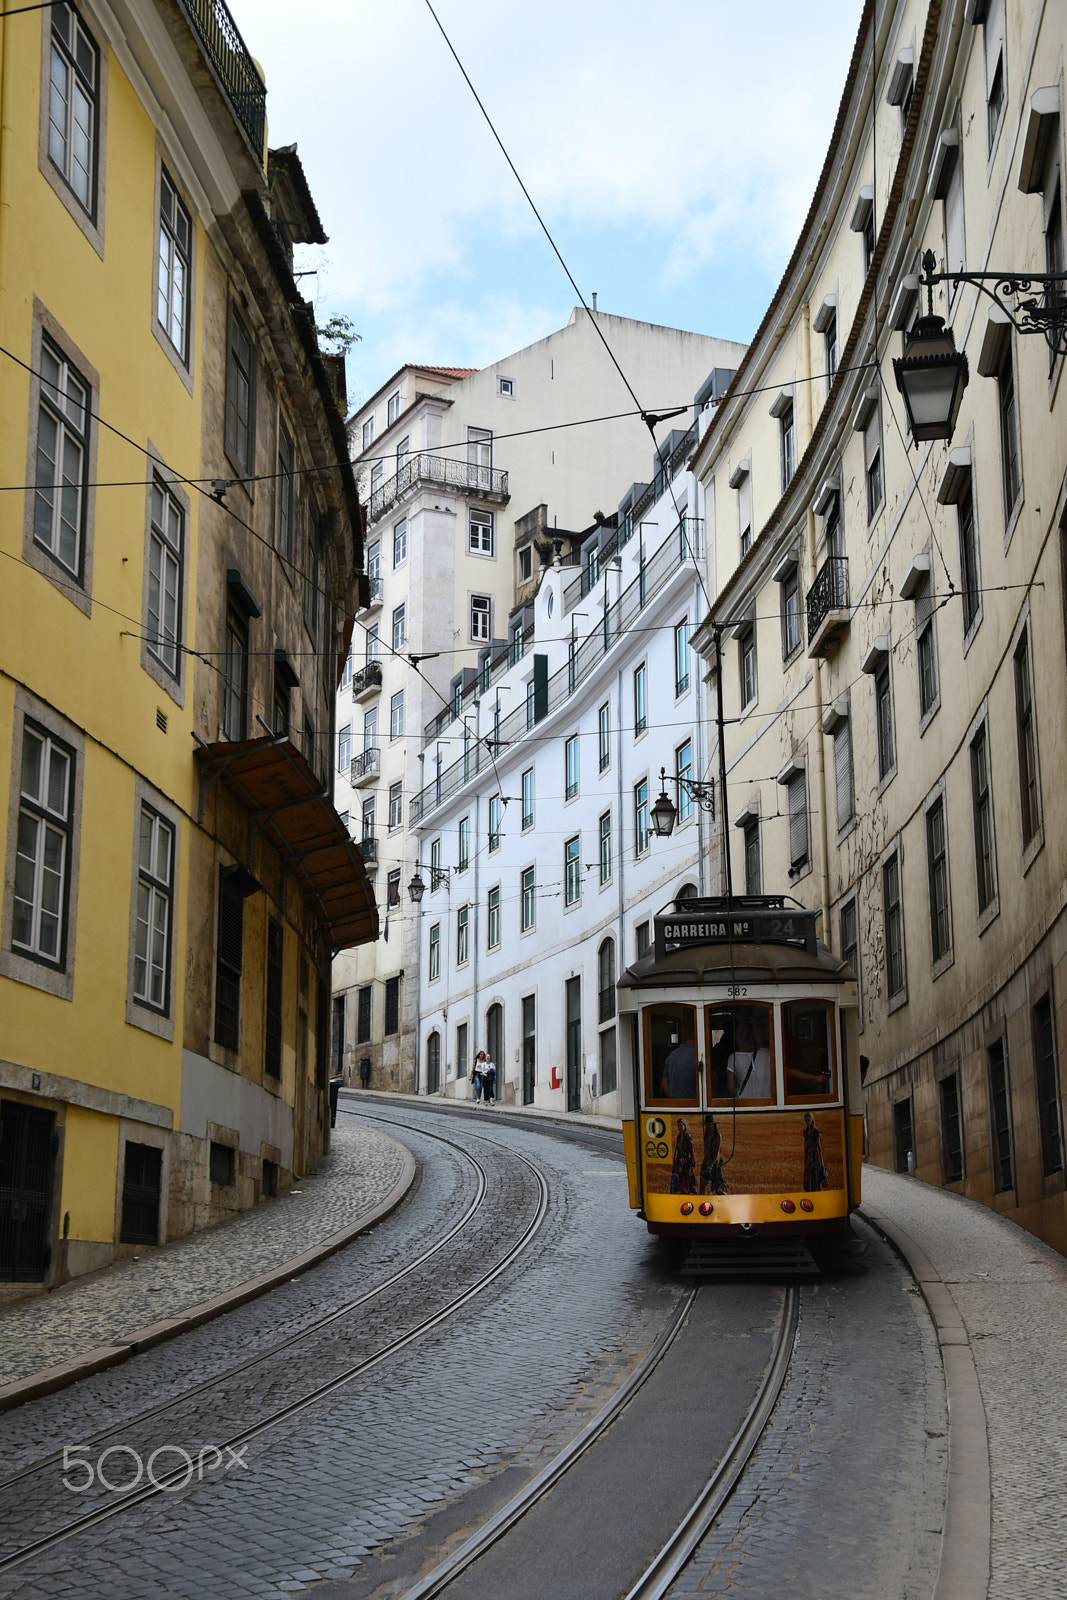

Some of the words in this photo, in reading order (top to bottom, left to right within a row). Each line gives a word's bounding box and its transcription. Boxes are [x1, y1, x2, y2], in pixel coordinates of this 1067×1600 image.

[664, 923, 727, 938] CARREIRA
[770, 919, 795, 935] 24
[727, 987, 748, 997] 582
